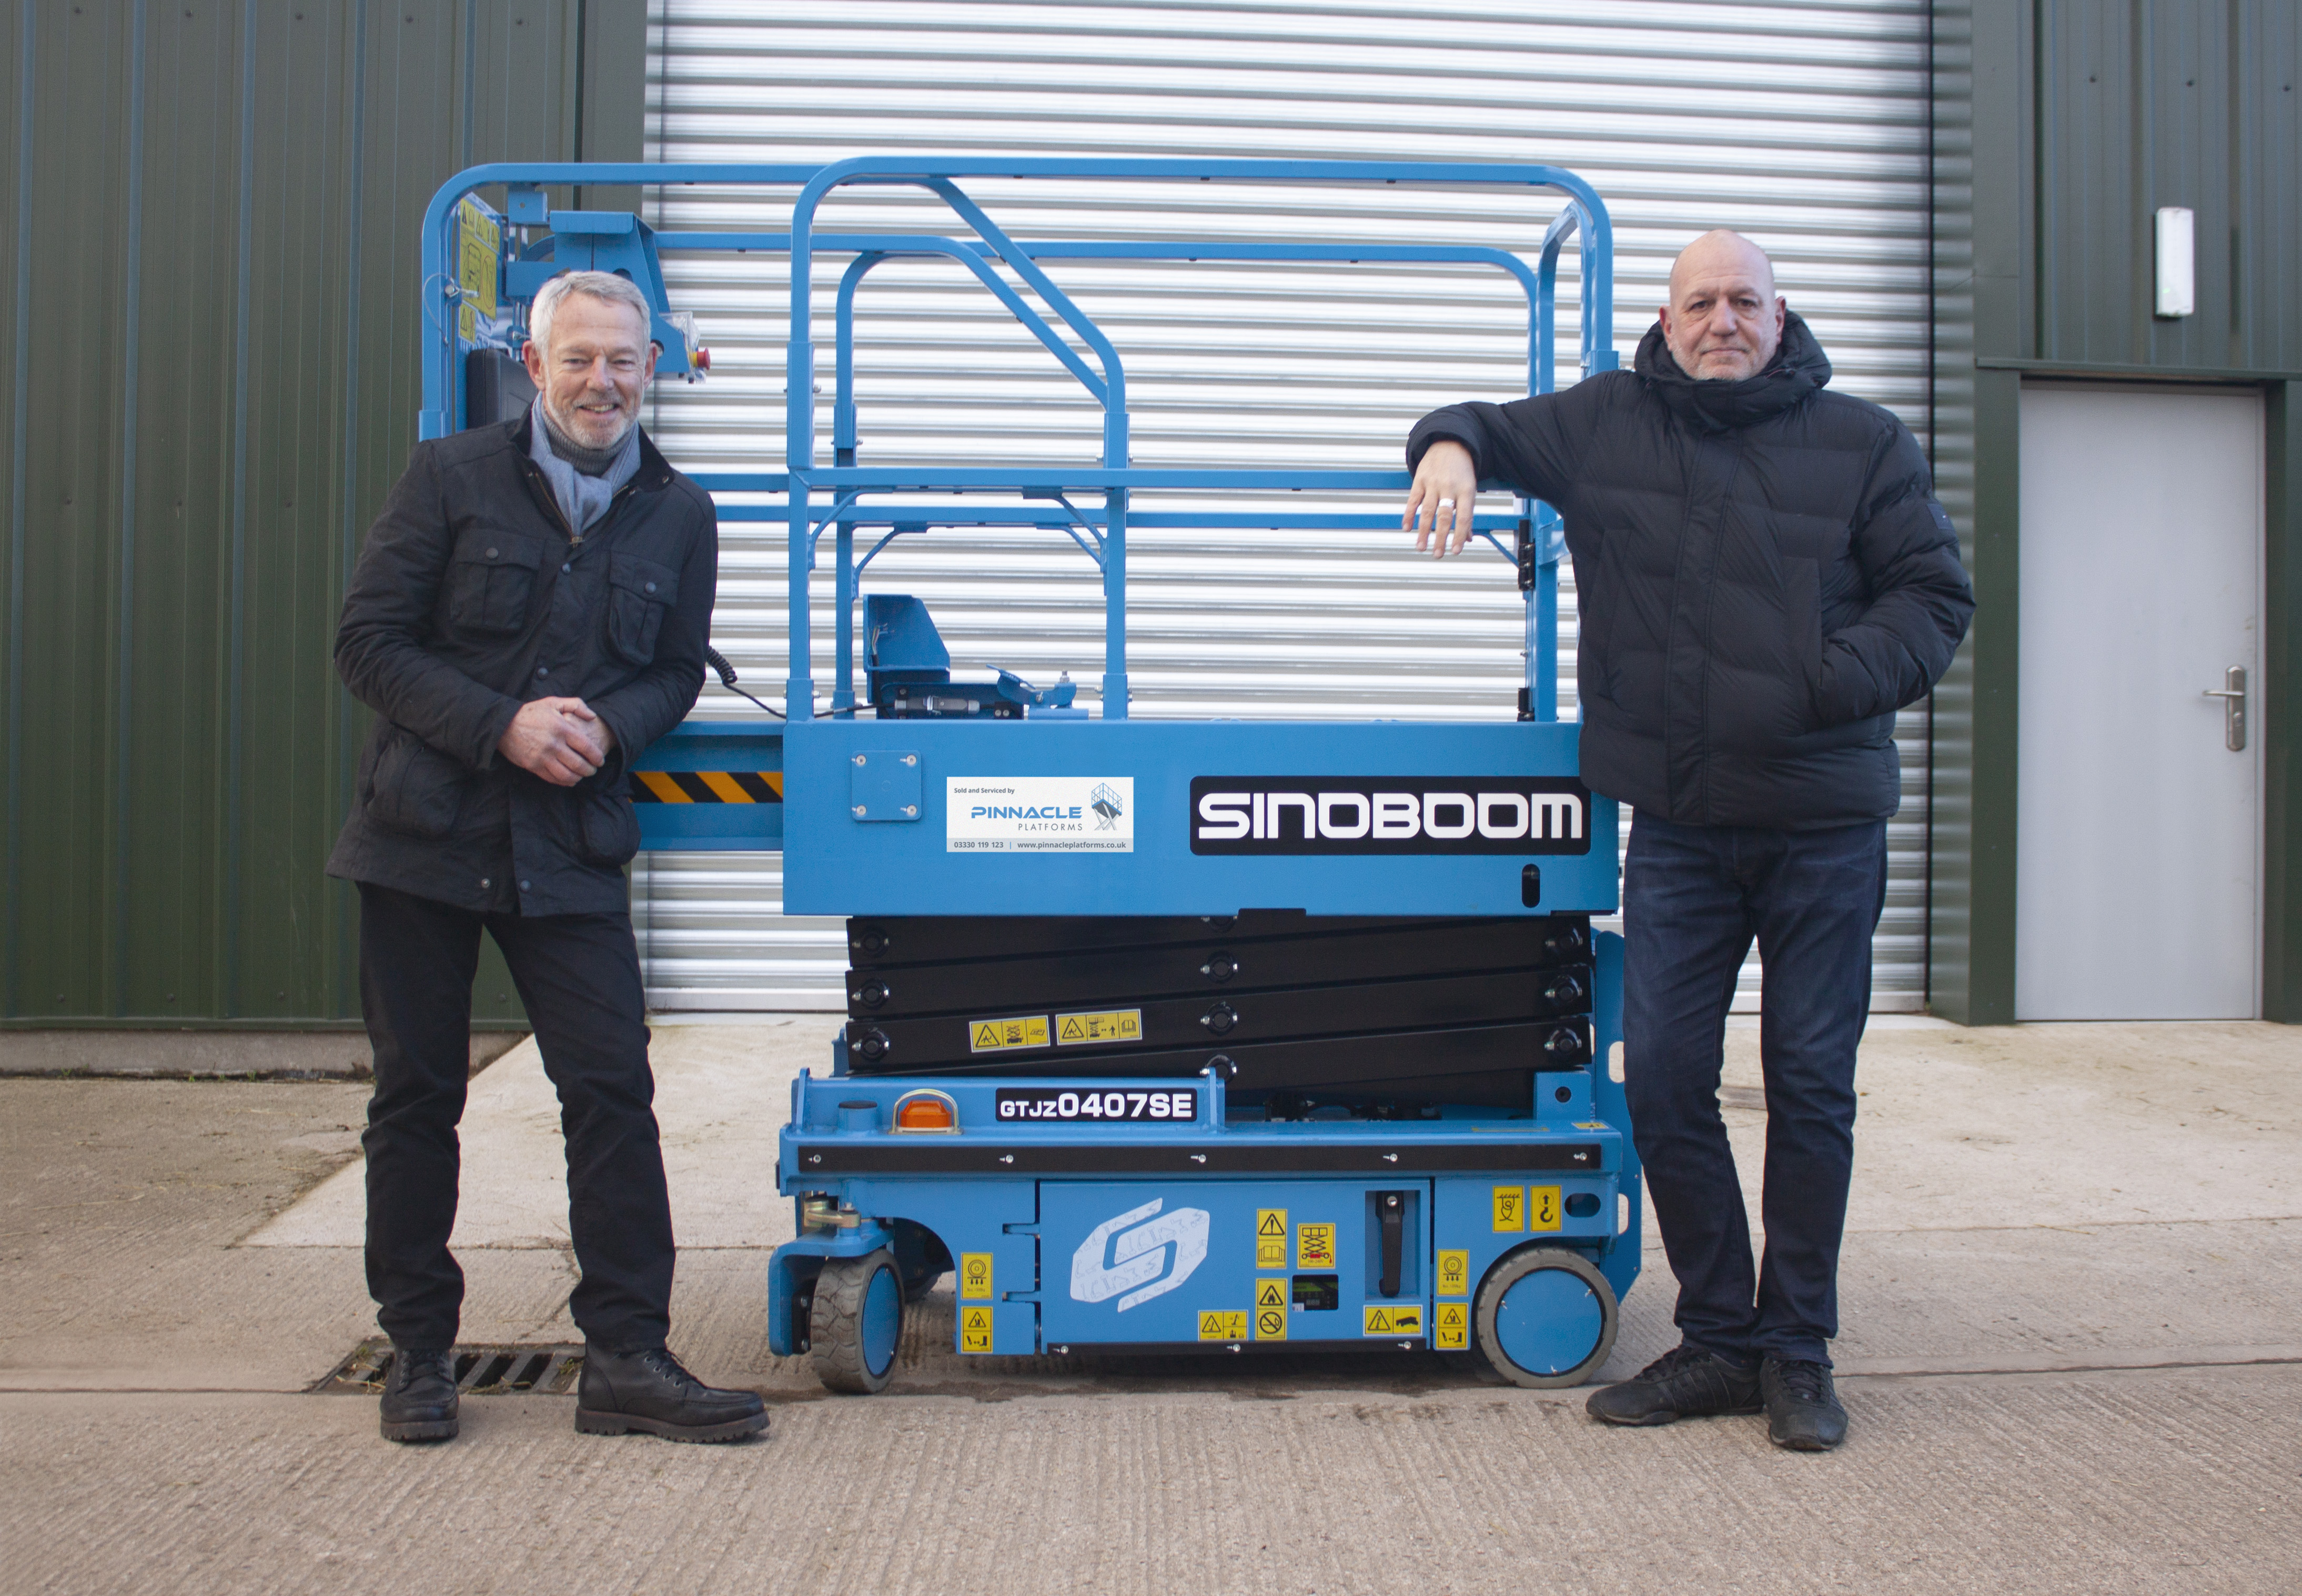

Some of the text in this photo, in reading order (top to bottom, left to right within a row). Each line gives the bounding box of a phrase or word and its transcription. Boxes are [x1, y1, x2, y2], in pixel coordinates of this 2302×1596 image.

[971, 806, 1082, 819] PINNACLE
[1198, 792, 1582, 839] SINOBOOM
[1017, 841, 1126, 850] www.pinnacleplatforms.co.uk
[1000, 1093, 1192, 1117] GTJZ0407SE
